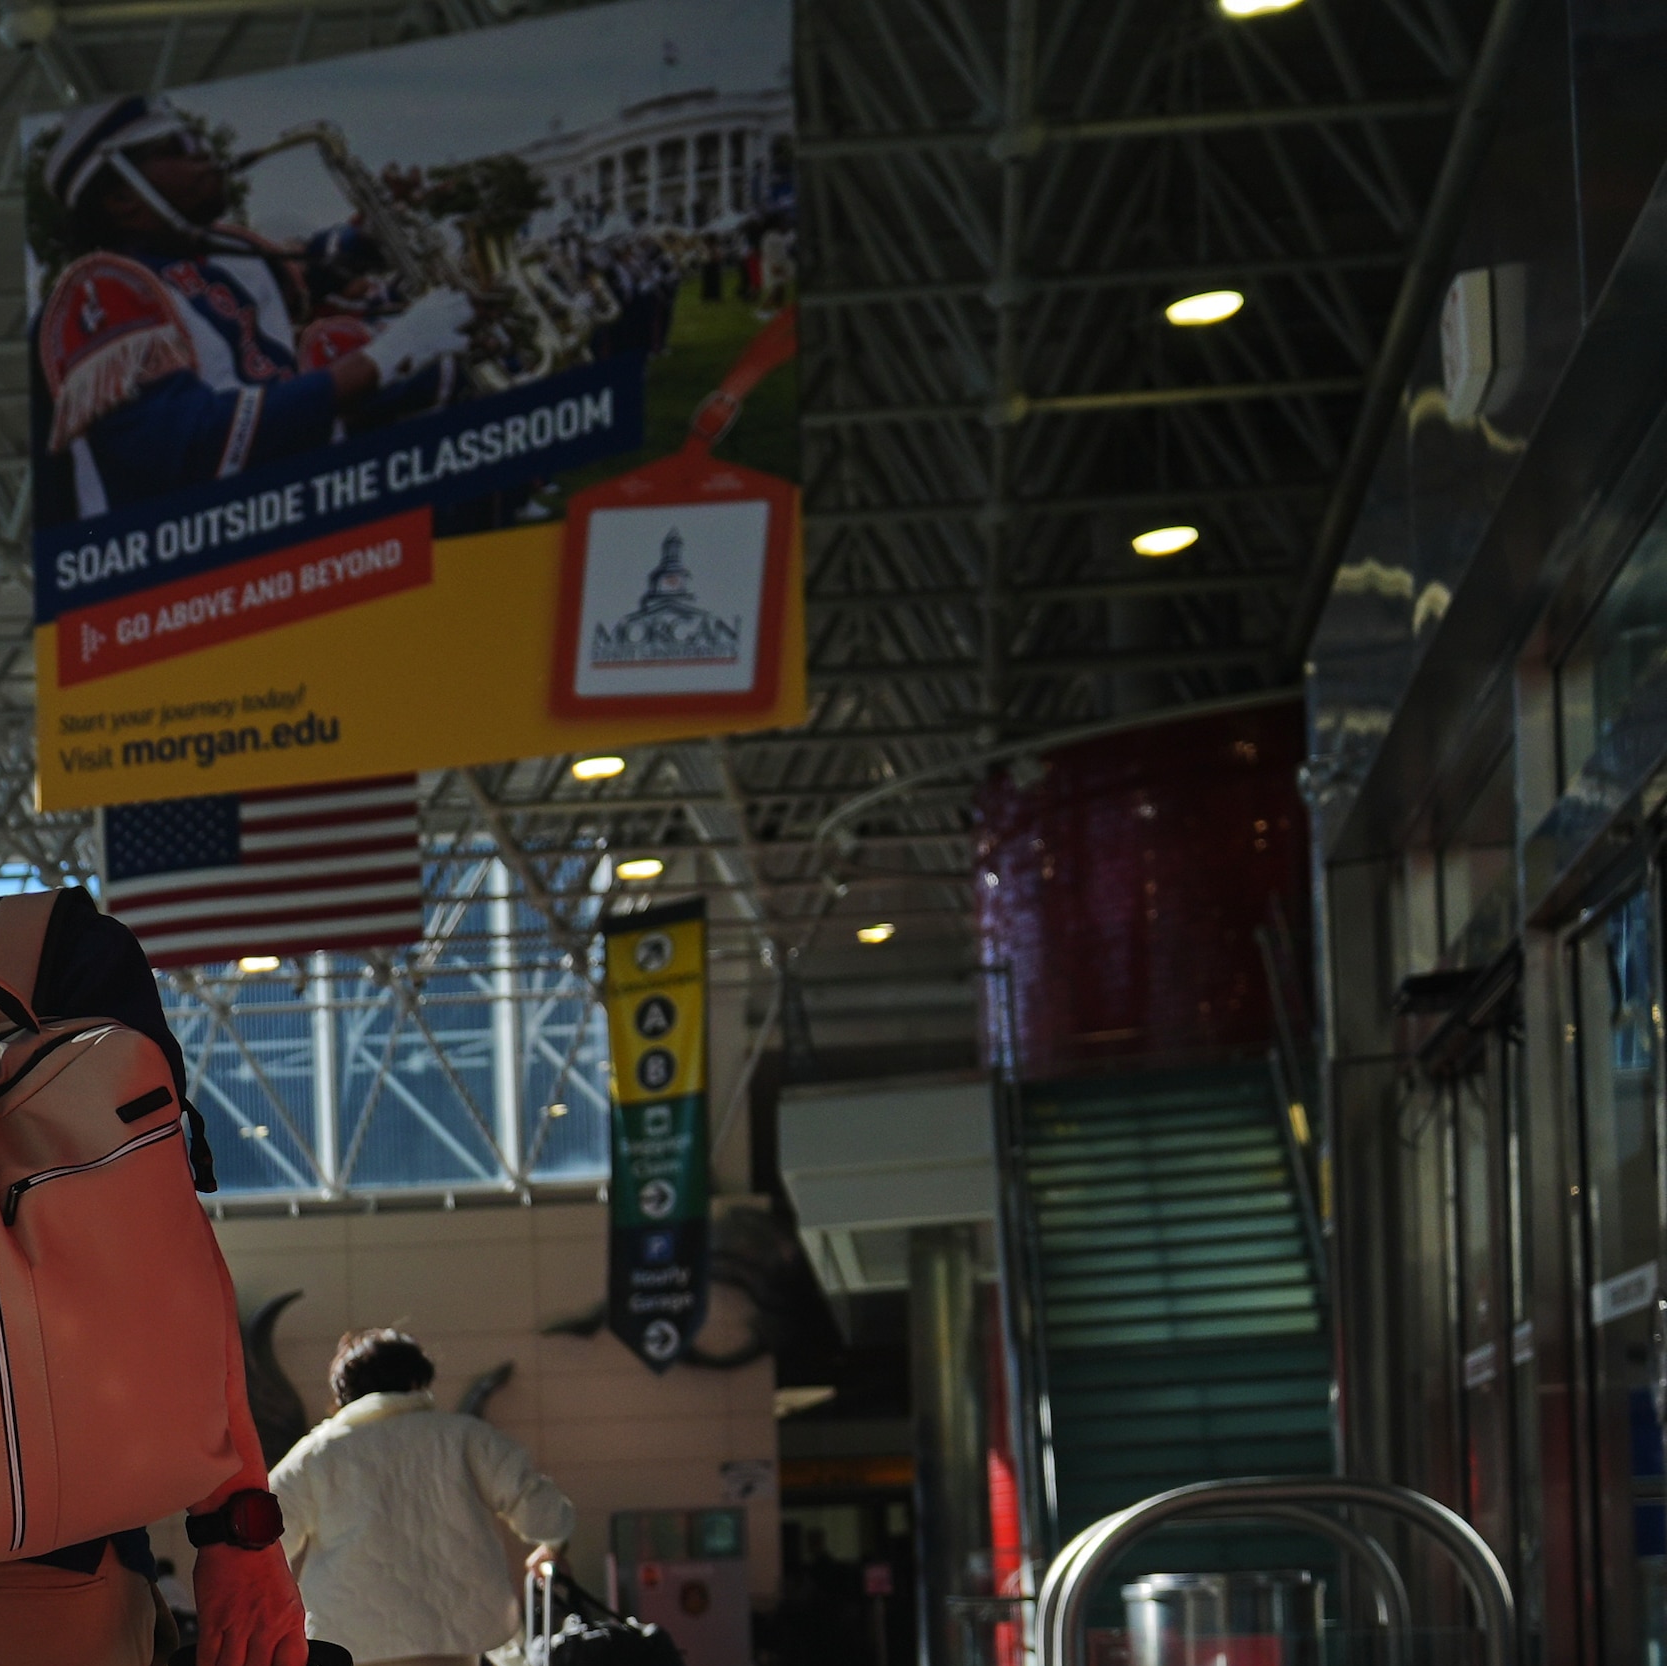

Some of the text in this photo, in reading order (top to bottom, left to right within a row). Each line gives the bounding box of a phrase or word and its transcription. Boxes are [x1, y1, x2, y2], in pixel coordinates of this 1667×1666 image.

[55, 387, 614, 590] SOAR OUTSIDE THE CLASSROOM
[116, 538, 402, 645] GO ABOVE AND BEYOND
[592, 615, 742, 650] MORGAN
[59, 683, 306, 734] Start your journey today!
[60, 711, 340, 772] Visit morgan.edu
[641, 1001, 668, 1031] A
